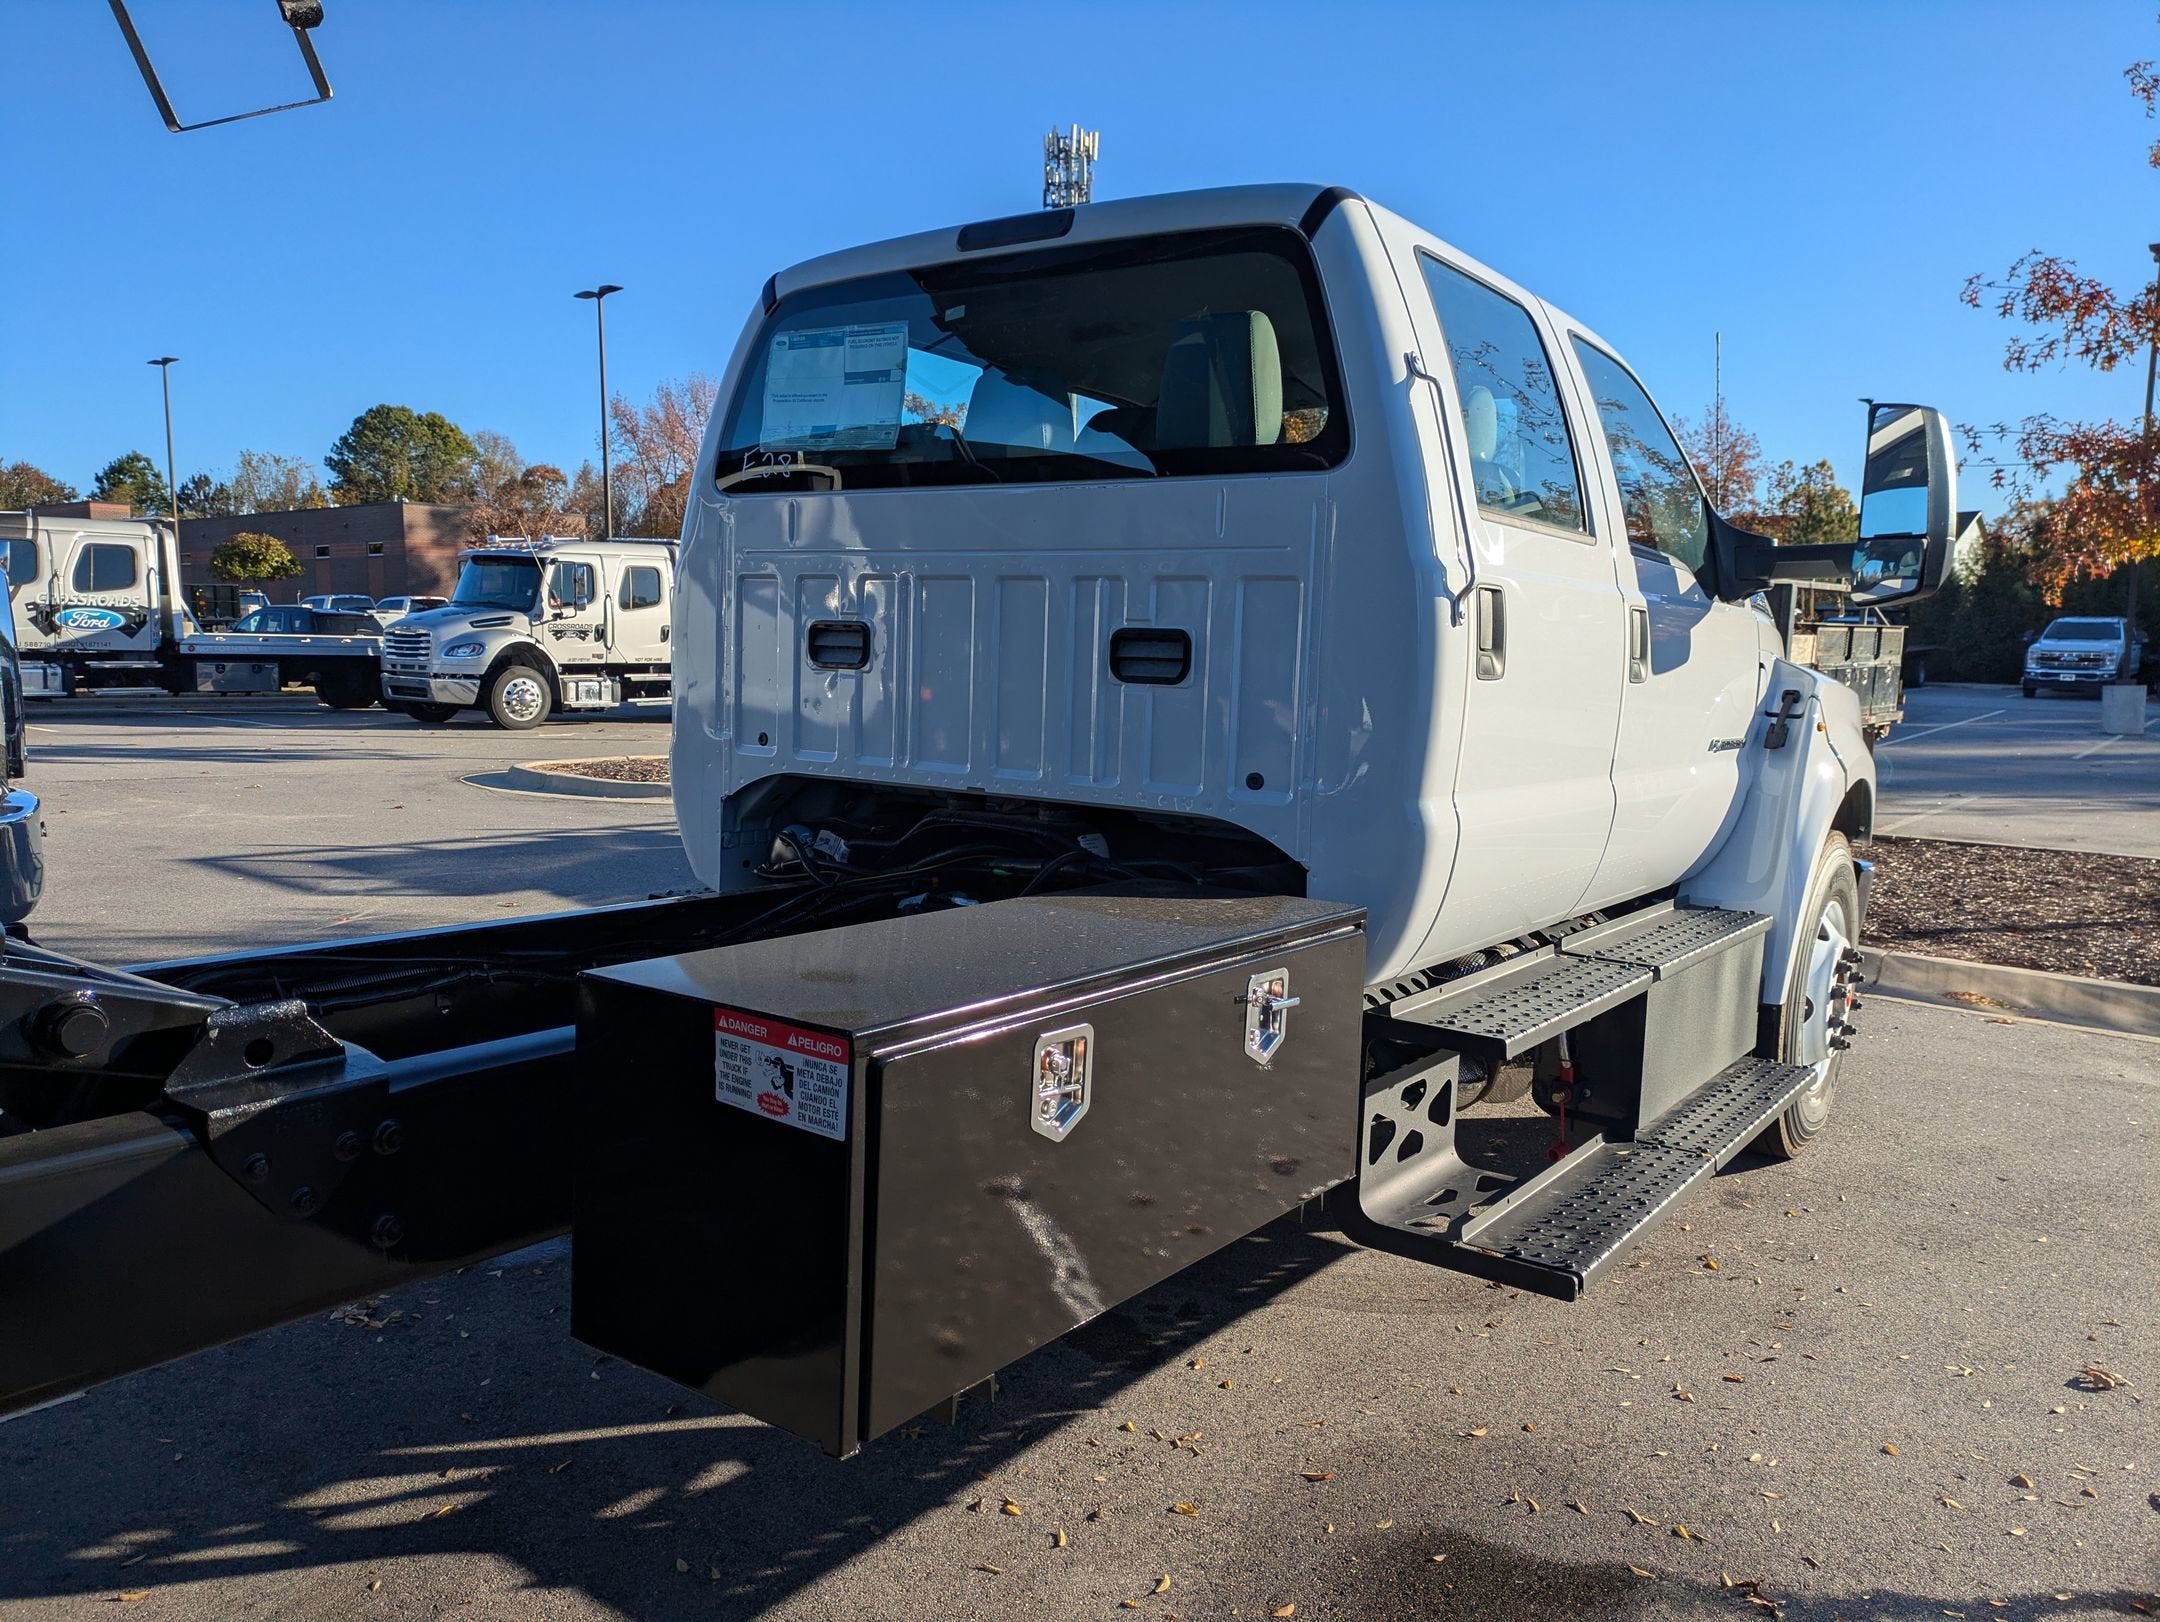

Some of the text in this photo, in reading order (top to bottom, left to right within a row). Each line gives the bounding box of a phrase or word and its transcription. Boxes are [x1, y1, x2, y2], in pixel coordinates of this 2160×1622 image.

[742, 447, 791, 481] E28
[35, 592, 141, 607] CROSSROADS
[68, 610, 111, 628] Ford
[548, 623, 593, 632] CROSSROADS
[728, 1018, 768, 1038] DANGER
[719, 1048, 738, 1062] UNDER
[720, 1038, 751, 1054] NEVER GET
[798, 1036, 842, 1057] PELIGRO
[722, 1061, 748, 1075] TRUCK IF
[829, 1064, 838, 1075] SE
[719, 1081, 724, 1090] IS
[720, 1070, 752, 1088] THE ENGINE
[797, 1067, 842, 1088] META DEBAJO
[798, 1080, 839, 1099] DEL CAMIÓN
[798, 1101, 821, 1116] MOTOR
[800, 1091, 837, 1109] CUANDO EL
[798, 1111, 806, 1122] EN
[808, 1114, 839, 1132] MARCHA!
